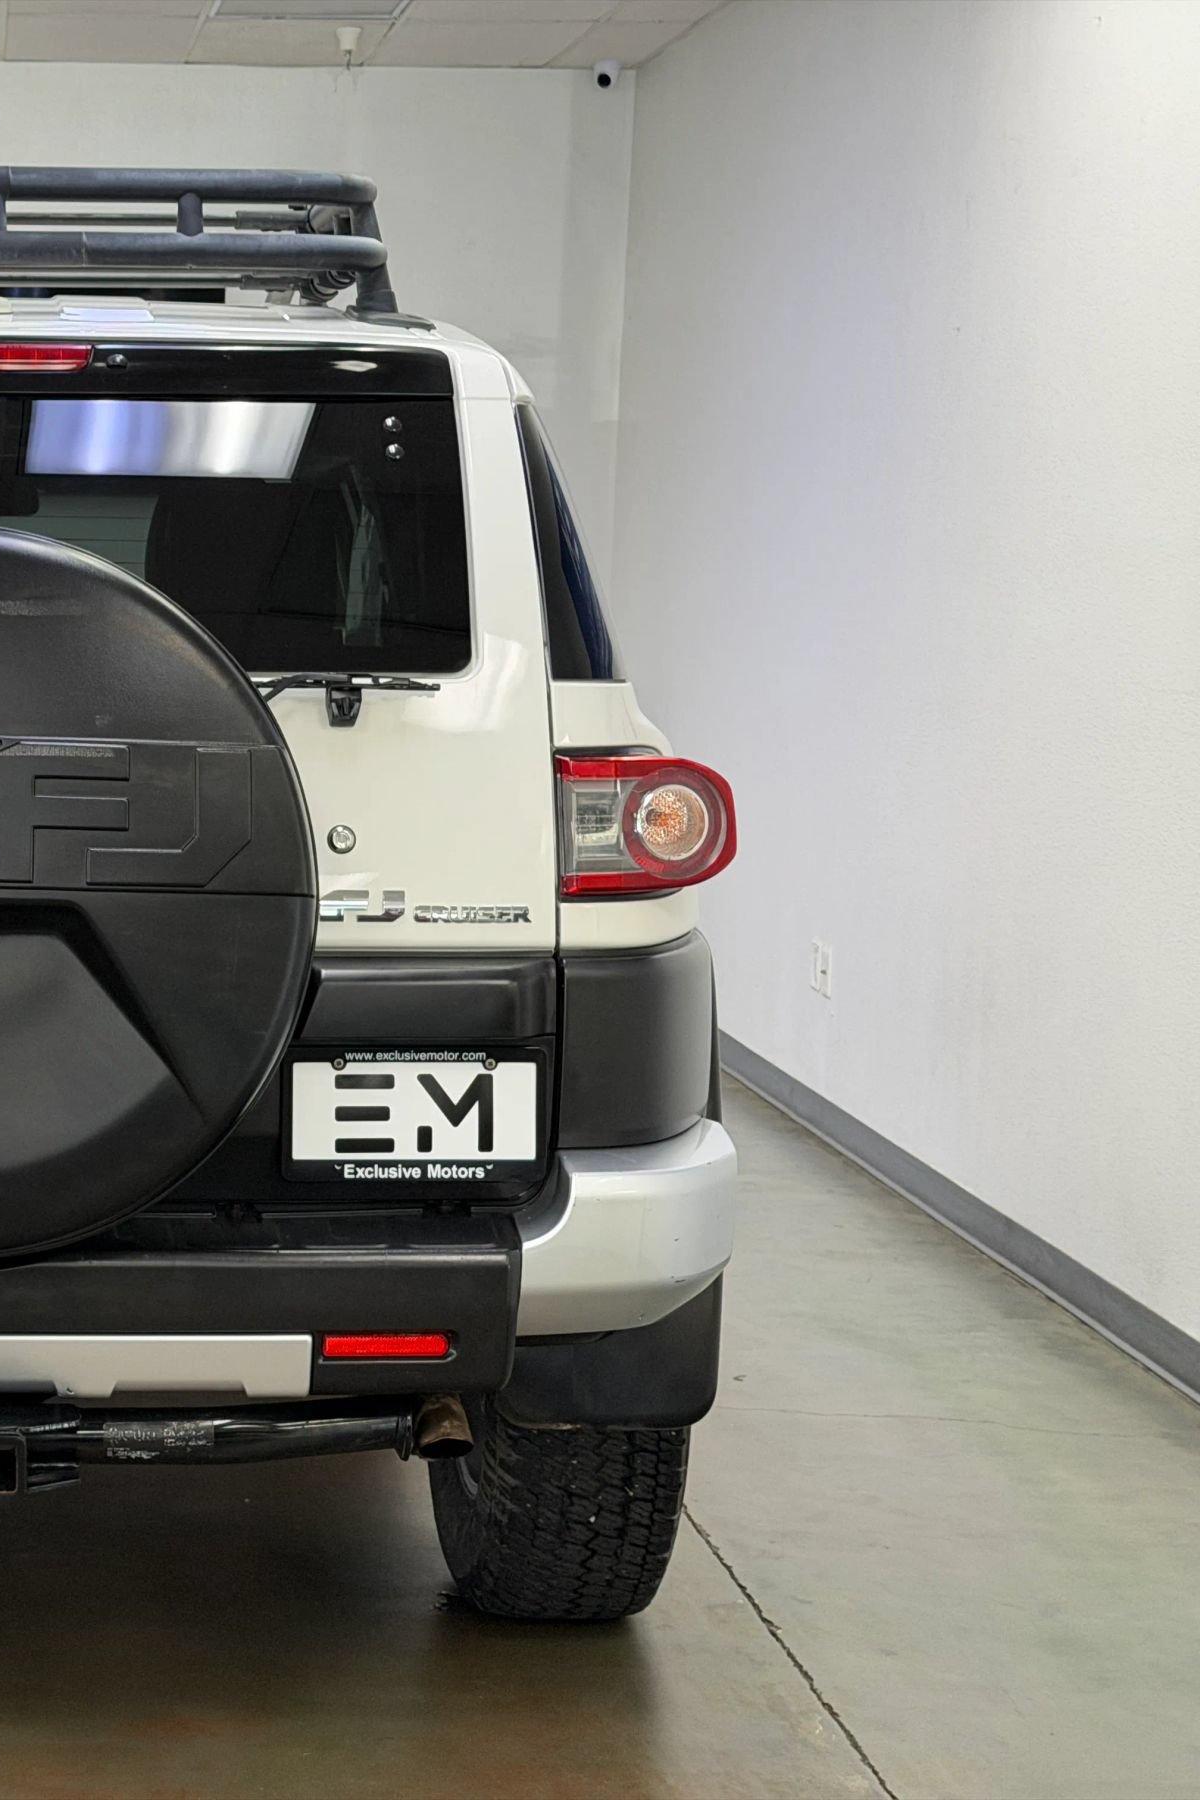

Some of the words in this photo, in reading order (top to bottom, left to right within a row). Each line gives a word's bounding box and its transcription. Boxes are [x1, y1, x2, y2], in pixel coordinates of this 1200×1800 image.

[413, 905, 532, 923] CRUISER
[344, 1051, 486, 1062] www.exclusivemotor.com
[334, 1073, 494, 1153] EM
[343, 1163, 421, 1179] Exclusive
[427, 1163, 485, 1179] Motors
